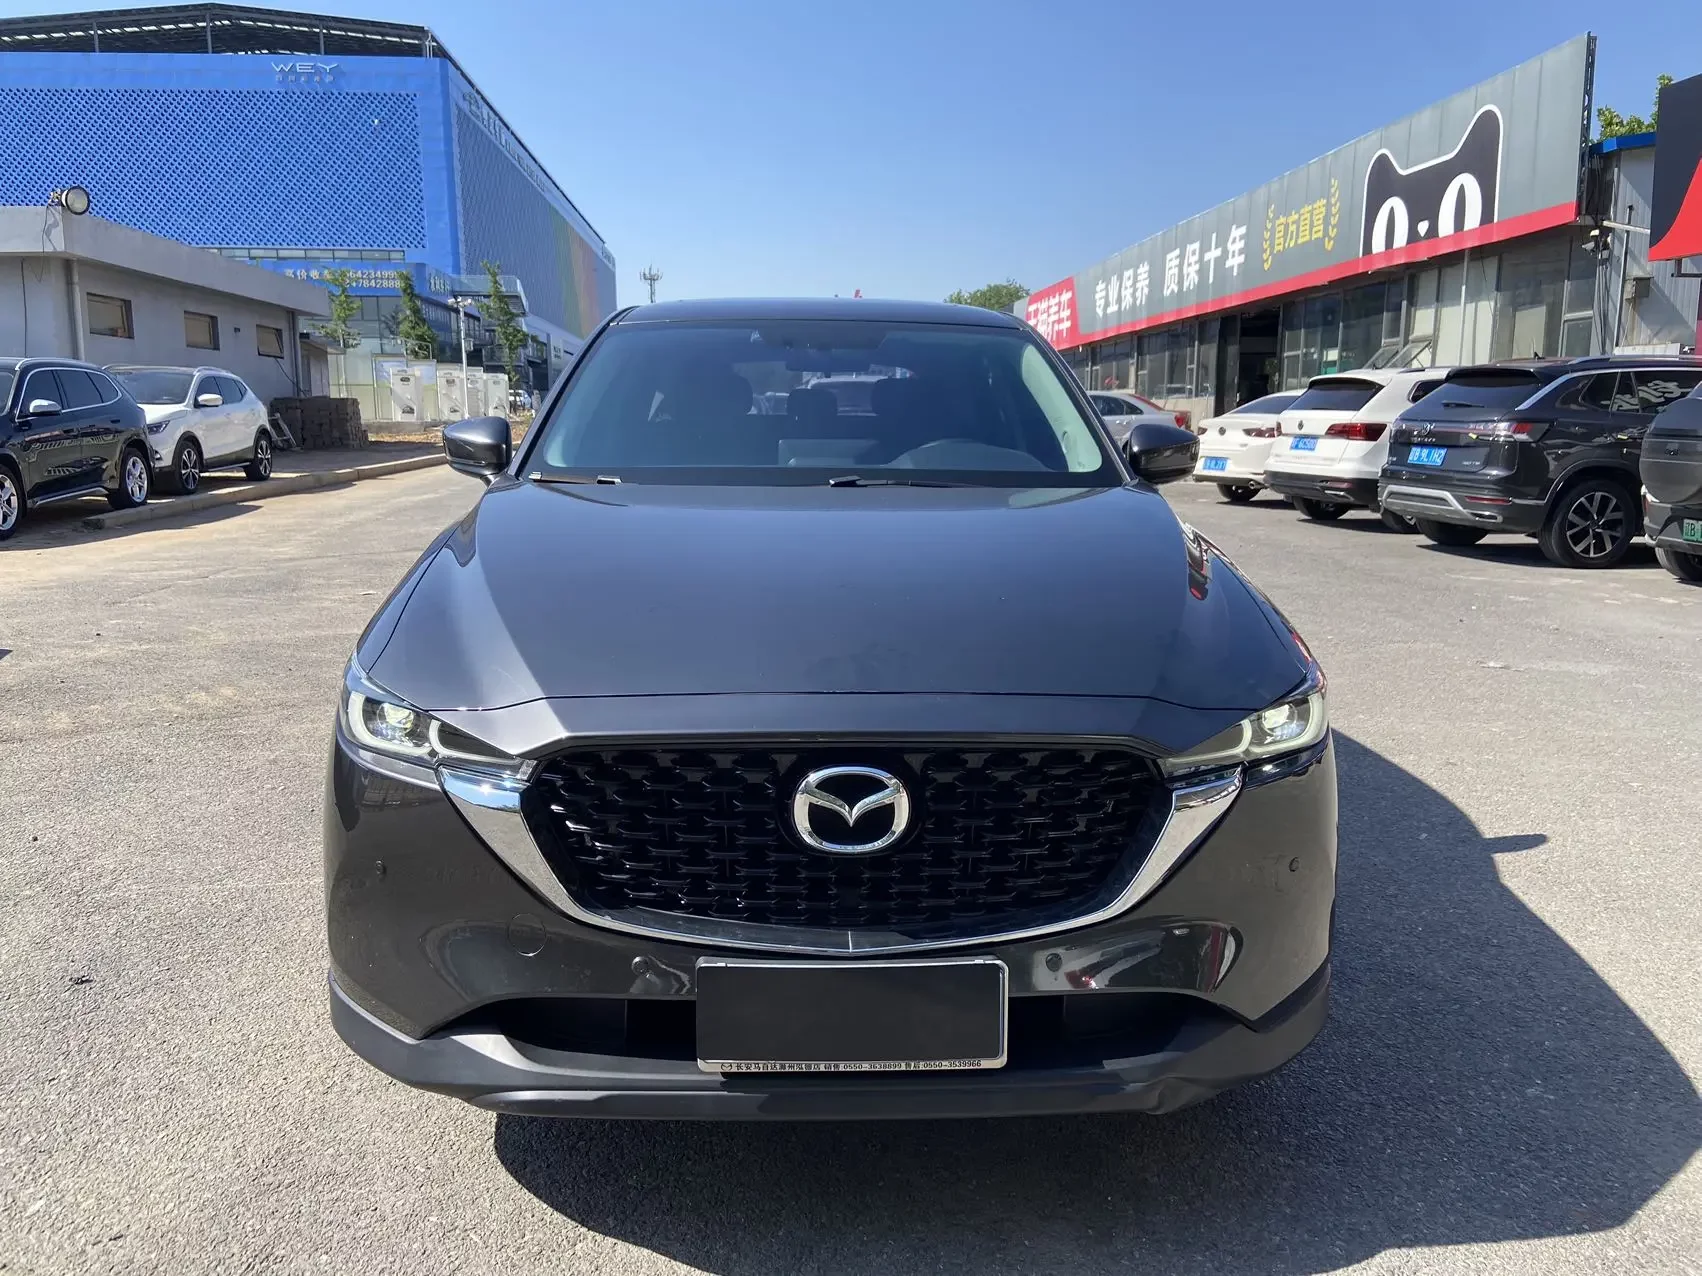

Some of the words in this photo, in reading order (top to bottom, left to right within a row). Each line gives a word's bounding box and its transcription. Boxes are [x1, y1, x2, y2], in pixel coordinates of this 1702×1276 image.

[271, 62, 337, 72] WEY
[1273, 198, 1327, 254] 官方直营
[1095, 260, 1150, 319] 专业保养
[1163, 224, 1248, 297] 质保十年
